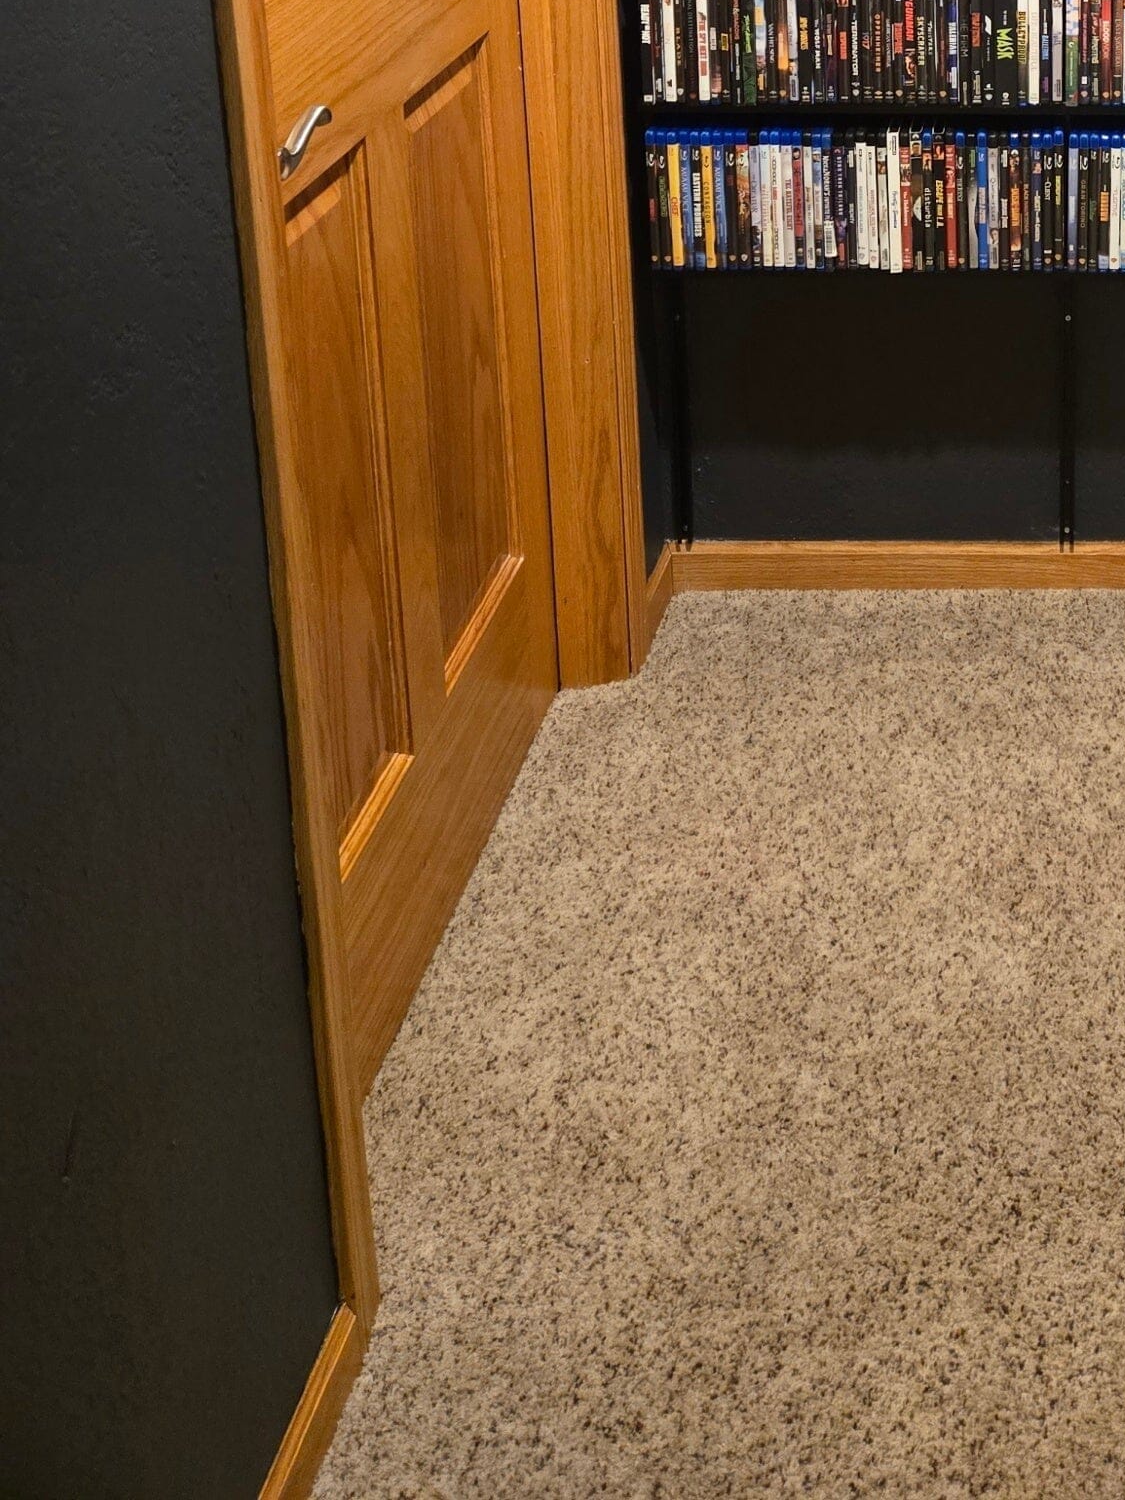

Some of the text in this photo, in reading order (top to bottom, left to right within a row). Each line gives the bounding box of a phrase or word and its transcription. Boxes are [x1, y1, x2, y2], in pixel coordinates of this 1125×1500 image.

[641, 30, 651, 45] NOT
[905, 1, 914, 42] GUNMAN
[916, 16, 925, 66] SKYSCRAPER
[996, 28, 1014, 60] MASK
[671, 197, 679, 216] CHEF
[692, 173, 702, 237] EASTERN PROMISES
[924, 187, 932, 228] disturbia
